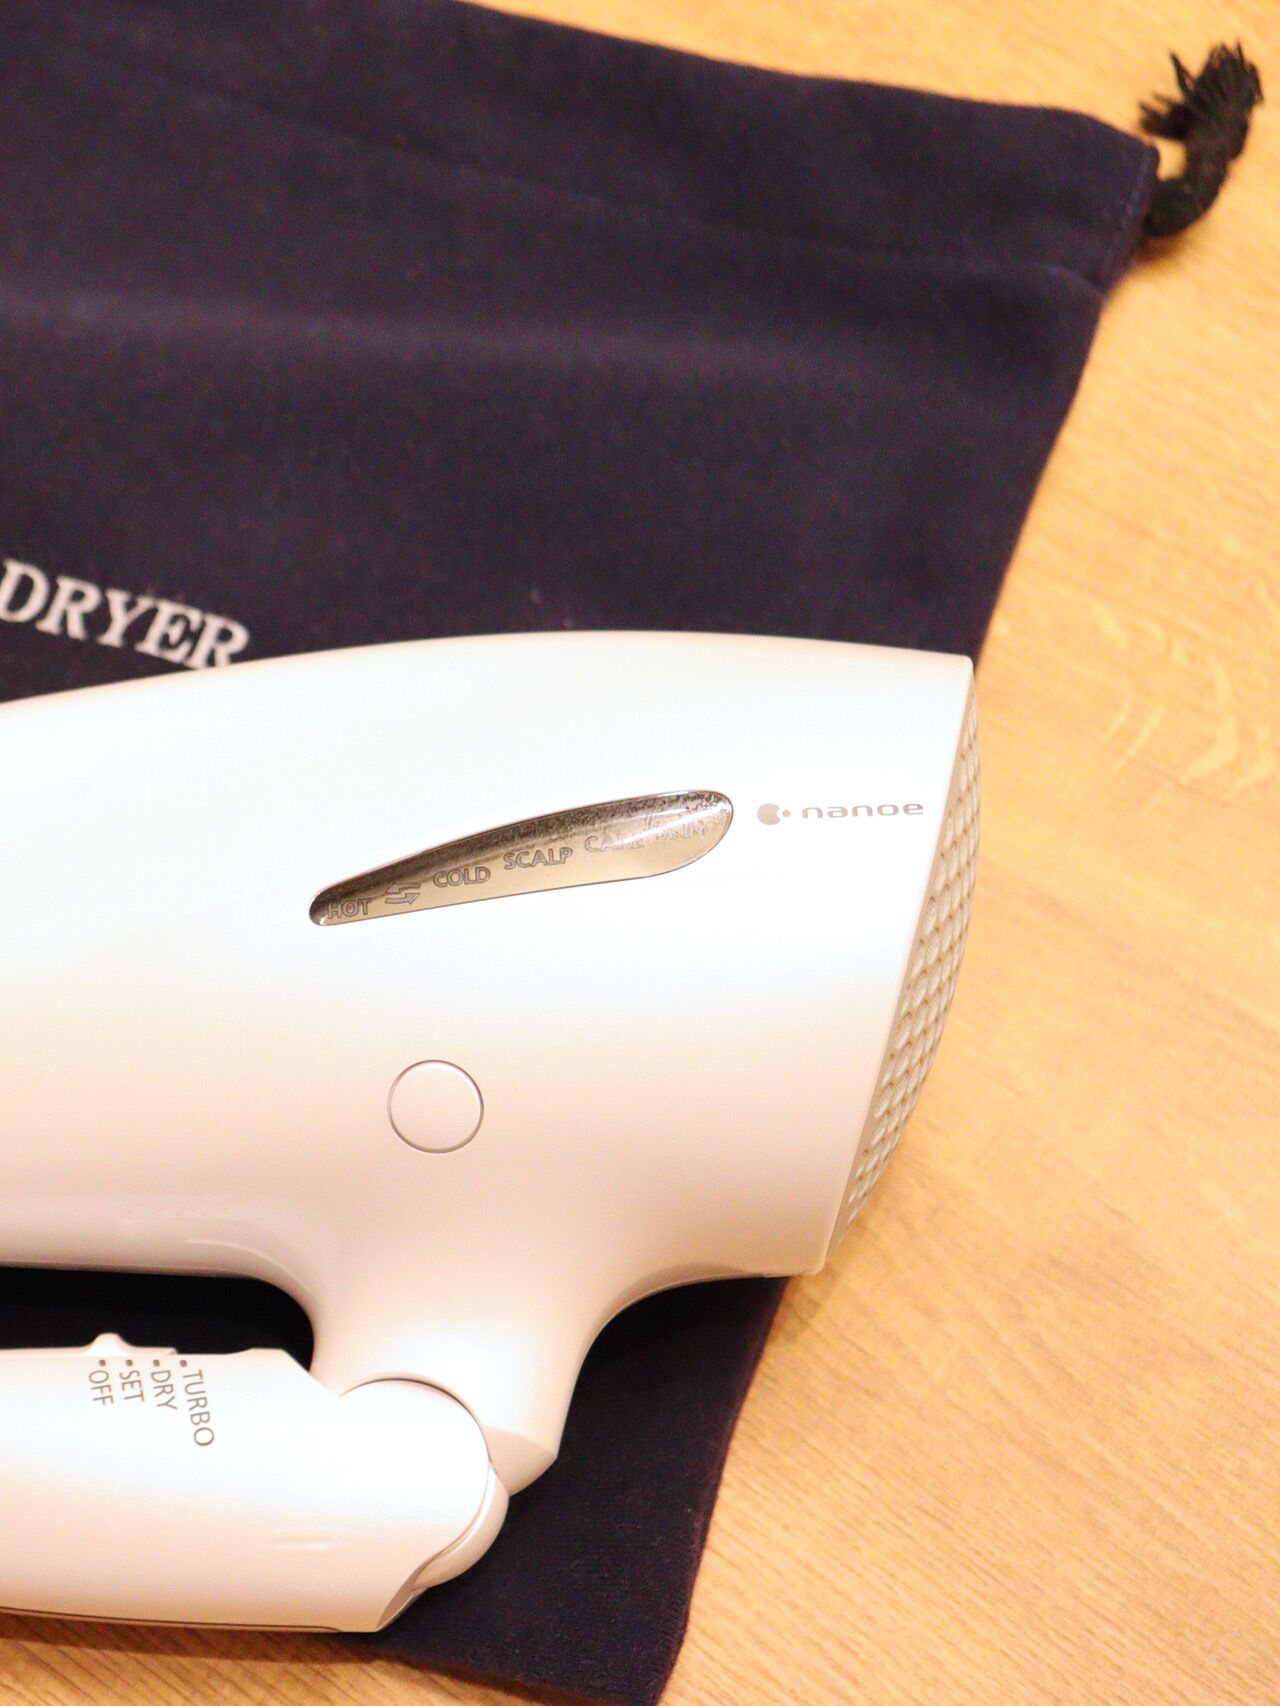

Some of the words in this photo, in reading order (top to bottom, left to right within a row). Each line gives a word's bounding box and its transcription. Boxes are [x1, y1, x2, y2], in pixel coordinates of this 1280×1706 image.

[802, 803, 924, 818] nanoe
[327, 899, 371, 919] HOT
[433, 866, 491, 888] COLD
[503, 847, 573, 870] SCALP
[88, 1370, 114, 1405] OFF
[119, 1370, 145, 1401] SET
[150, 1370, 178, 1410] DRY
[182, 1369, 215, 1447] TURBO
